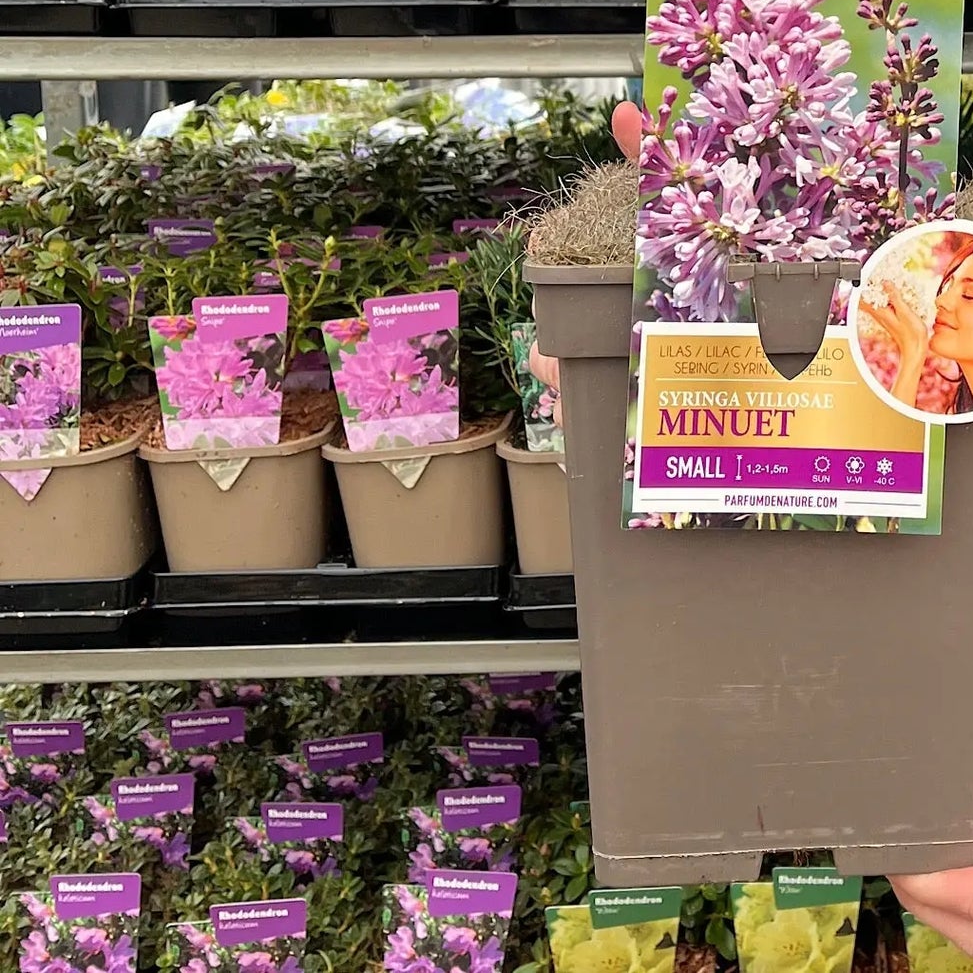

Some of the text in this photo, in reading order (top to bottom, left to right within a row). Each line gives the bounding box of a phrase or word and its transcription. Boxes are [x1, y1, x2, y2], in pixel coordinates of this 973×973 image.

[200, 303, 270, 315] Rhododendron
[372, 301, 440, 316] Rhododendron
[0, 314, 61, 326] hododendron
[659, 345, 692, 358] LILAS
[706, 346, 741, 358] LILAC
[733, 362, 768, 375] SYRIN
[658, 390, 835, 409] SYRINGA VILLOSAE
[656, 408, 796, 437] MINUET
[666, 455, 789, 479] SMALL 1,2-1,5m
[811, 474, 831, 483] SUN
[846, 476, 863, 485] V-VI
[724, 495, 838, 508] PARFUMDENATURE.COM
[118, 782, 179, 795] Rhododendron
[444, 794, 506, 806] Rhododendron
[58, 881, 124, 893] Rhododendron
[433, 877, 499, 891] Rhododendron
[778, 875, 844, 886] Rhododendron
[594, 895, 663, 906] Rhododendron
[218, 908, 289, 921] Rhododendron
